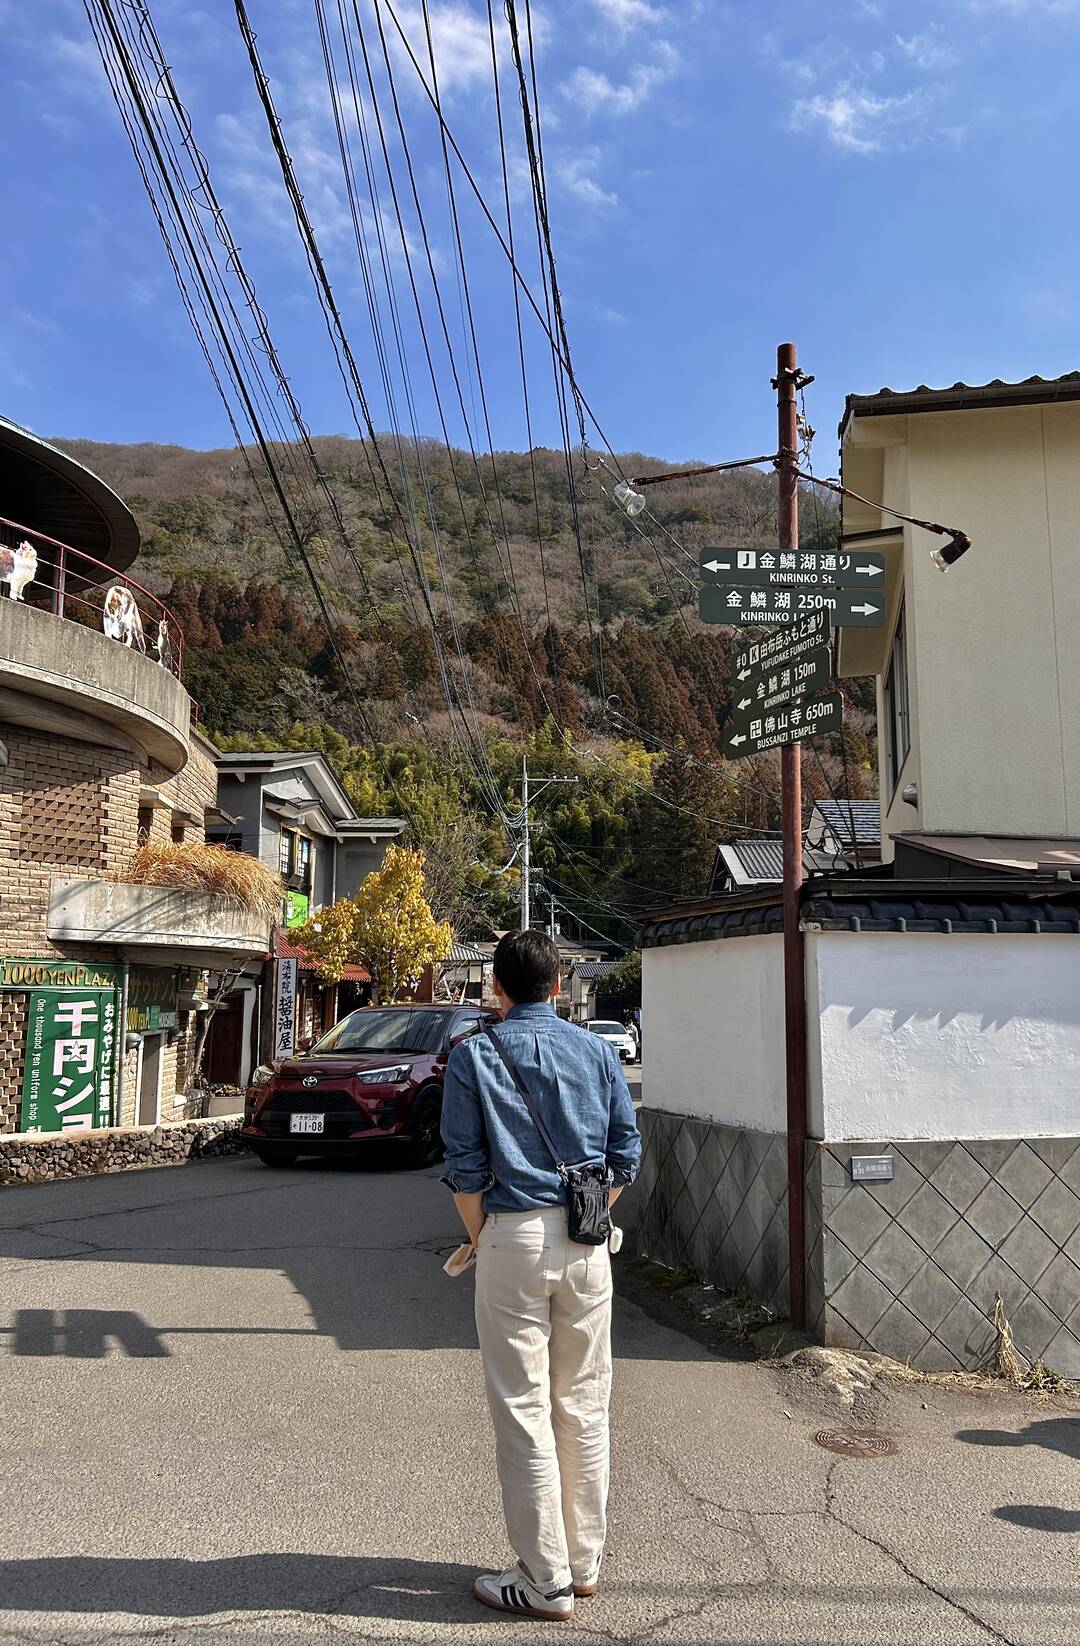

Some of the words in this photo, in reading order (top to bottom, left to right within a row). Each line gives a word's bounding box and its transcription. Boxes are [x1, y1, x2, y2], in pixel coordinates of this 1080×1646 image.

[759, 552, 851, 571] 金鱗湖通り
[769, 573, 818, 583] KINRINKO
[822, 574, 835, 584] St.
[798, 595, 836, 609] 250m
[741, 612, 790, 622] KINRINKO
[761, 651, 790, 671] YUFUDAKE
[790, 637, 815, 659] FUMOTO
[794, 662, 816, 682] 150m
[764, 691, 790, 709] KINRINKO
[791, 682, 807, 697] LAKE
[806, 701, 834, 721] 650m
[757, 733, 788, 750] BUSSANZI
[790, 724, 817, 740] TEMPLE
[36, 999, 46, 1011] One
[32, 1052, 41, 1066] yen
[30, 1070, 40, 1100] uniform
[28, 1103, 39, 1120] shop
